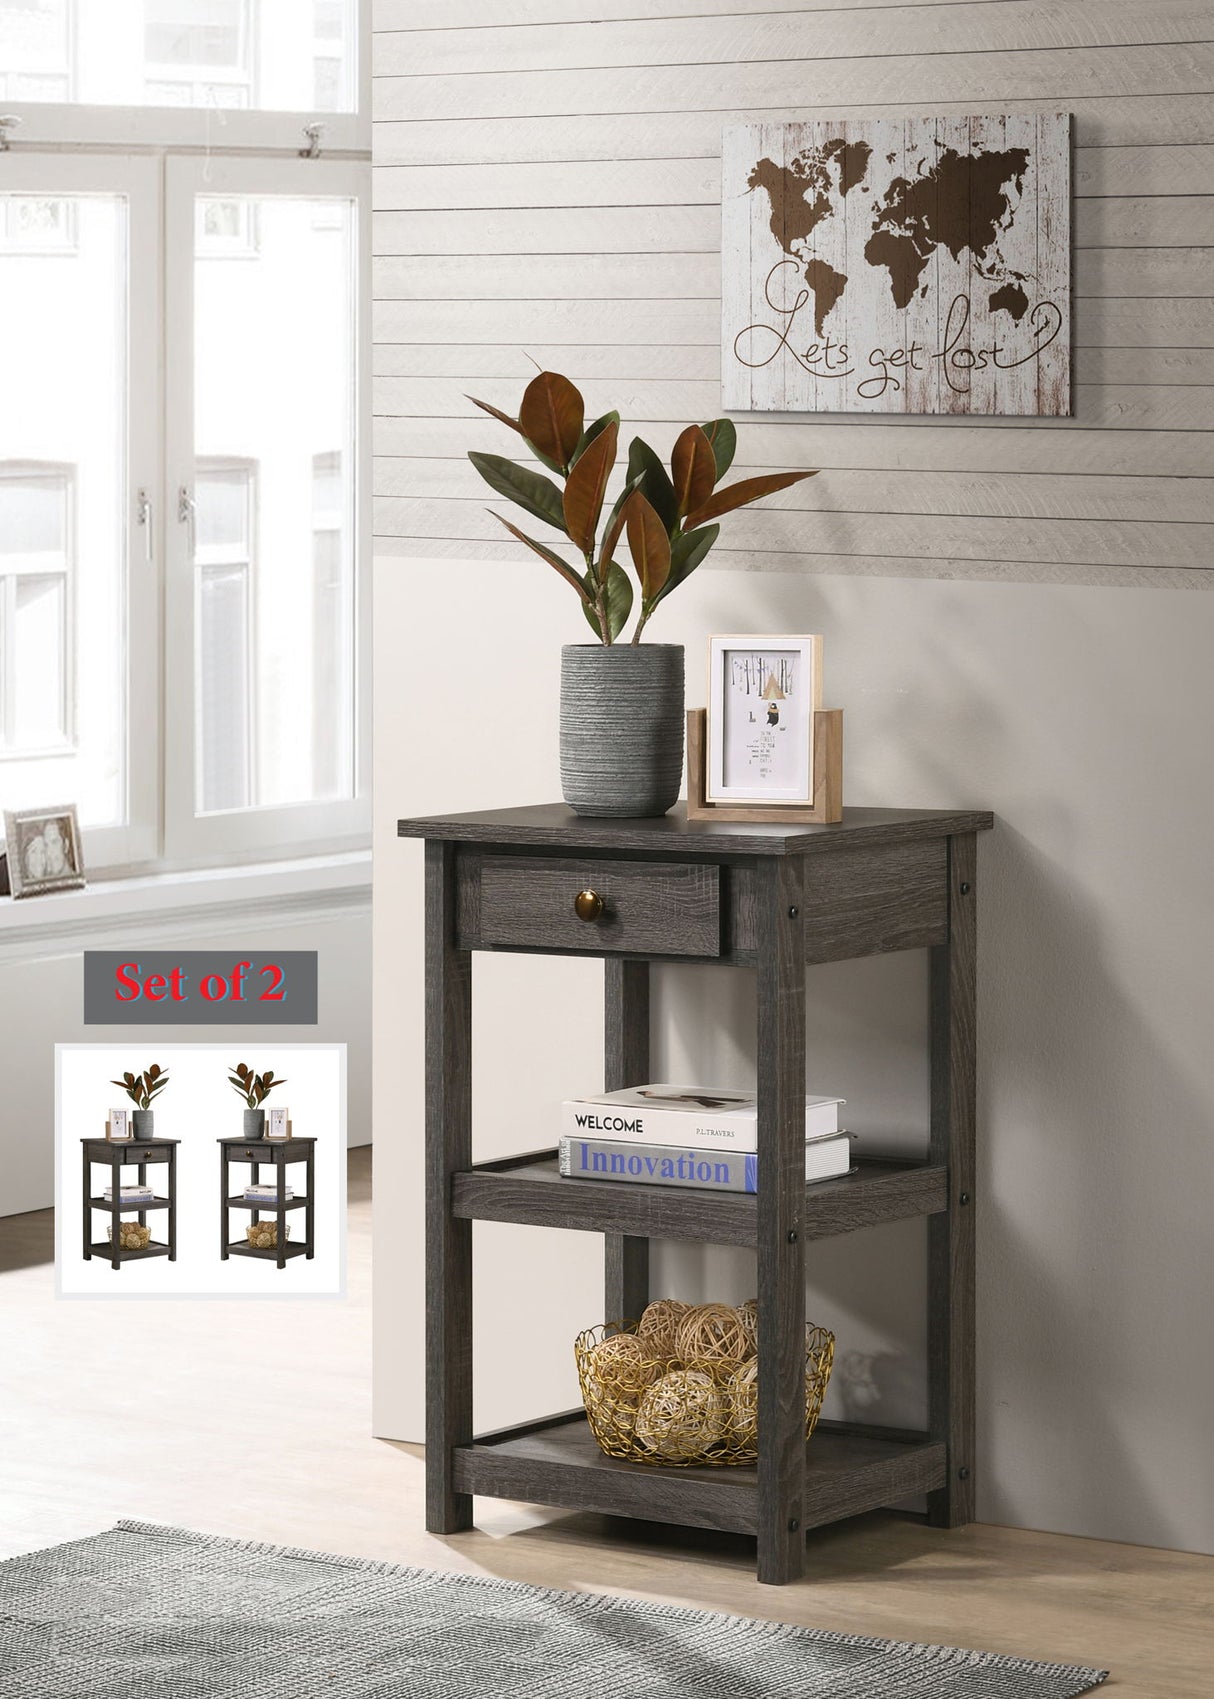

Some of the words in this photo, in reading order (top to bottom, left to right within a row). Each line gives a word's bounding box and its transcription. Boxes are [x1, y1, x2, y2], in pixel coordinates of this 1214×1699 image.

[734, 260, 855, 378] Lets
[857, 341, 923, 398] get
[932, 293, 1062, 393] lost
[574, 1114, 643, 1133] WELCOME
[579, 1142, 730, 1184] Innovation
